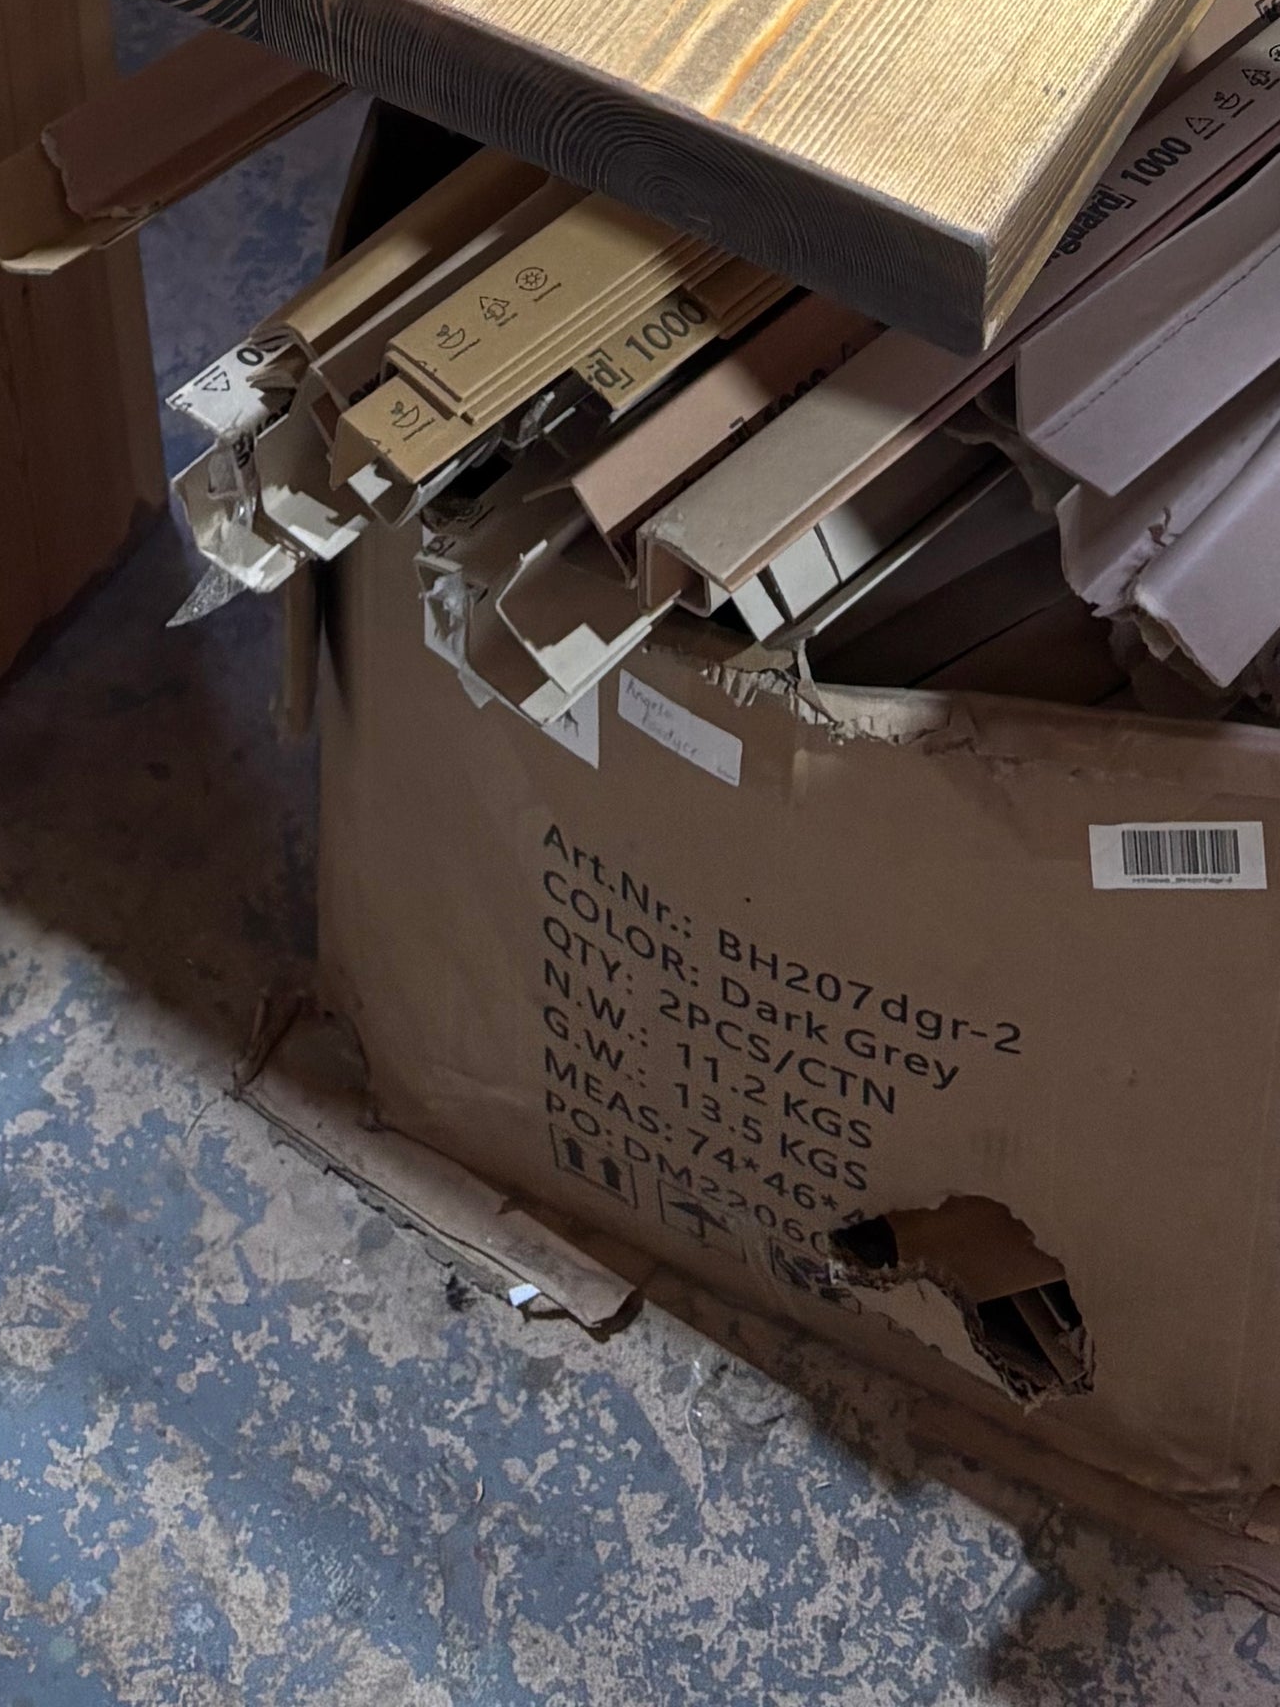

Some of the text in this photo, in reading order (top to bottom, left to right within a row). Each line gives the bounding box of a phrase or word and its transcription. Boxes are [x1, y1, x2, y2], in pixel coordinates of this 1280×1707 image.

[1121, 137, 1192, 187] 1000
[624, 298, 708, 362] 1000
[543, 823, 1022, 1055] Art.Nr.: BH207dgr-2
[543, 870, 960, 1091] COLOR: Dark Grey
[543, 916, 896, 1115] QTY: 2PCS/CTN
[543, 1005, 868, 1191] G.W.: 13.5 KGS
[544, 958, 873, 1149] N.W.: 11.2 KGS
[544, 1046, 672, 1143] MEAS:
